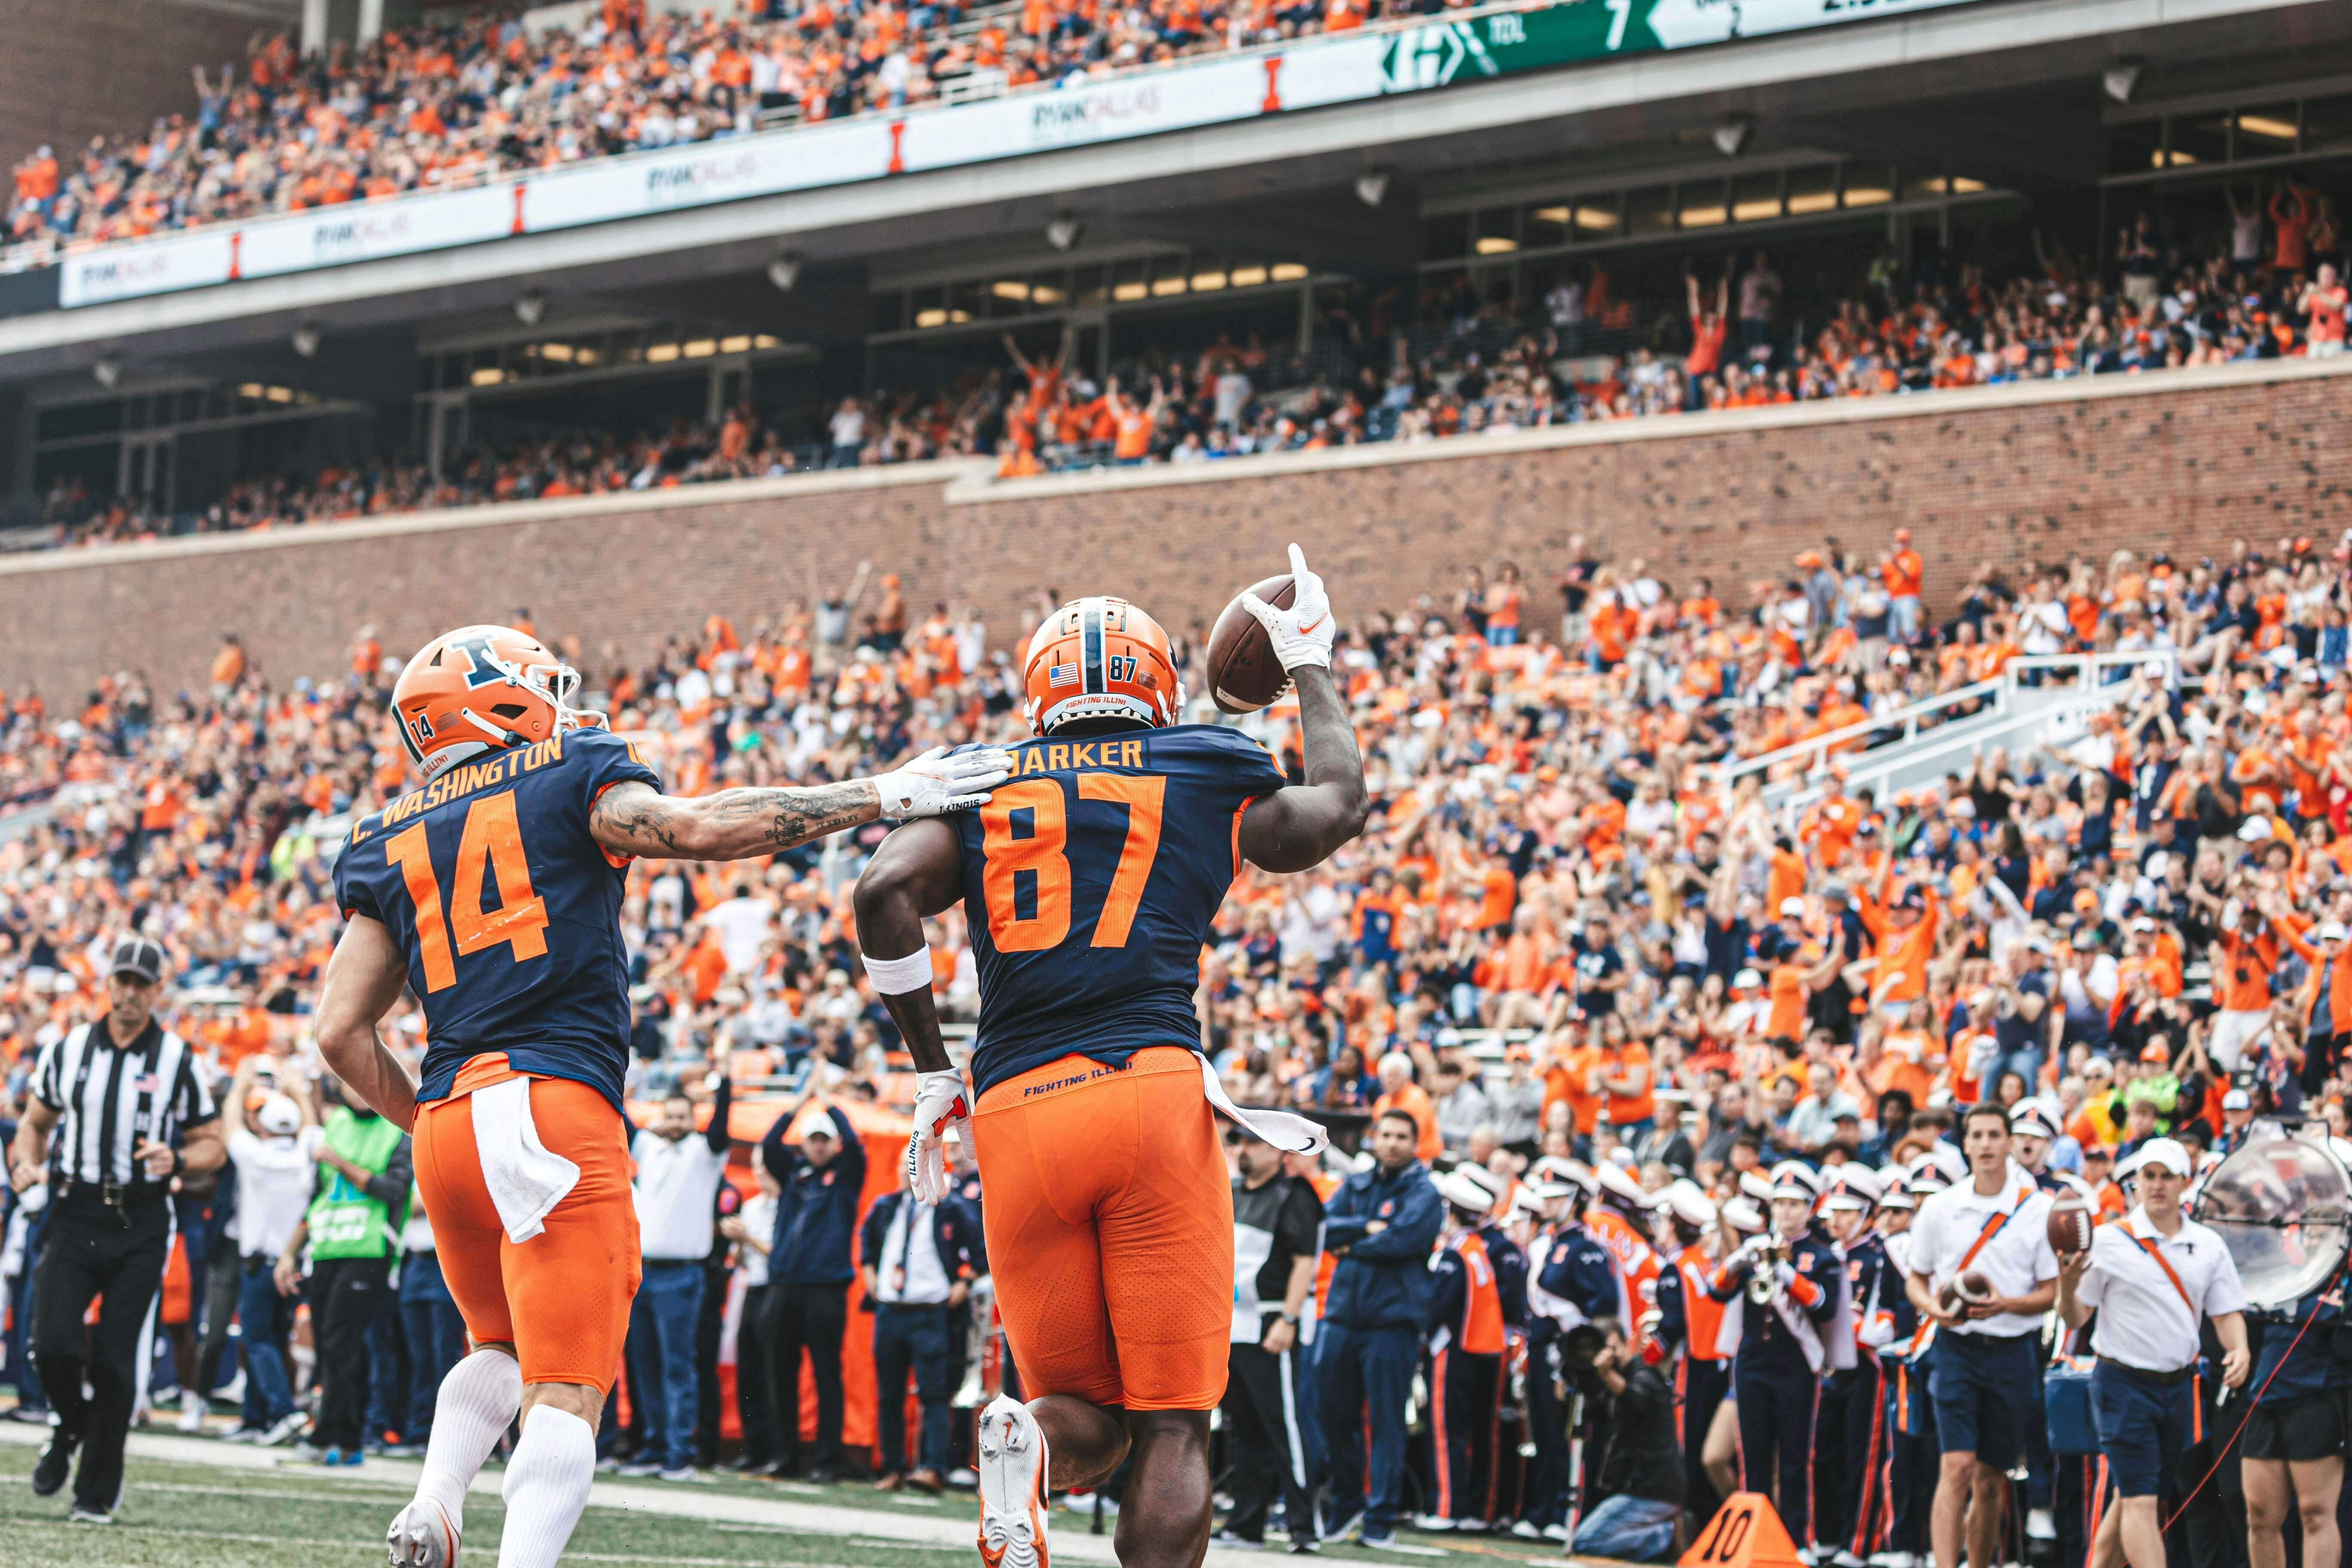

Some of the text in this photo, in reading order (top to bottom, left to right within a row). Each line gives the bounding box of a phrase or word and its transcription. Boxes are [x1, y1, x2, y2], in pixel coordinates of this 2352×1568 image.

[1109, 655, 1138, 683] 87
[1066, 696, 1126, 709] FIGHTING ILLINI
[410, 713, 435, 744] 14
[382, 732, 563, 828] WASHINGTON
[428, 754, 449, 775] ILLINI
[940, 799, 980, 814] ILLINOIS
[980, 772, 1167, 953] 87
[385, 789, 549, 994] 14
[1024, 1073, 1087, 1097] FIGHTING
[910, 1130, 919, 1176] ILLINOIS
[1702, 1508, 1752, 1562] 10
